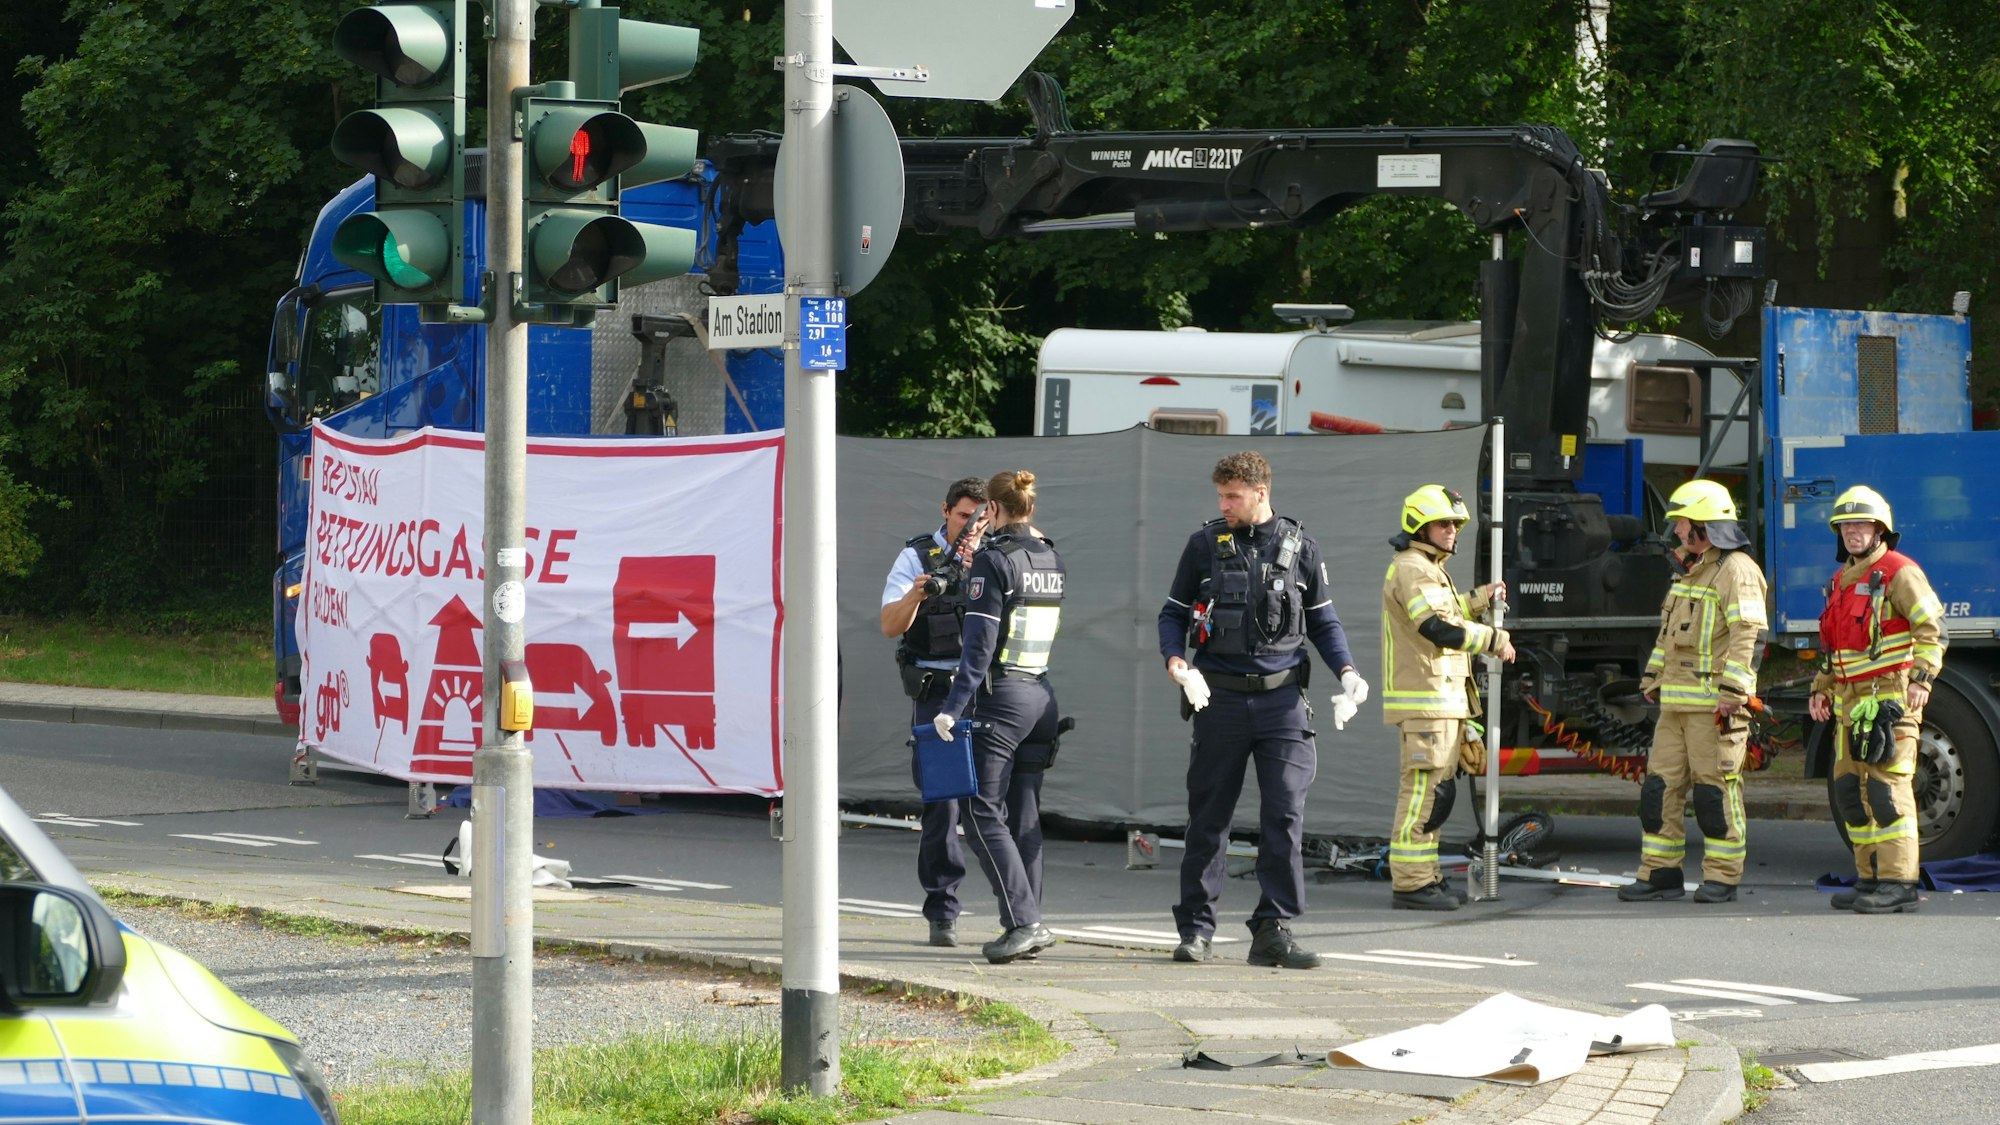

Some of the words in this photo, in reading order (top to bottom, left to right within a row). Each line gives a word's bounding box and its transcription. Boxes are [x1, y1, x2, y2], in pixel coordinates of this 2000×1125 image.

[1091, 150, 1132, 161] WINNEN
[1141, 147, 1193, 170] MKG
[1112, 160, 1132, 168] Polch
[825, 300, 843, 312] 829
[713, 306, 732, 337] Am
[736, 303, 782, 336] Stadion
[826, 312, 843, 323] 100
[322, 455, 348, 496] BEI
[344, 464, 382, 506] STAU
[1022, 572, 1064, 594] POLIZE
[1520, 583, 1565, 594] WINNEN
[1543, 594, 1564, 602] Polch
[1943, 602, 1971, 617] LER
